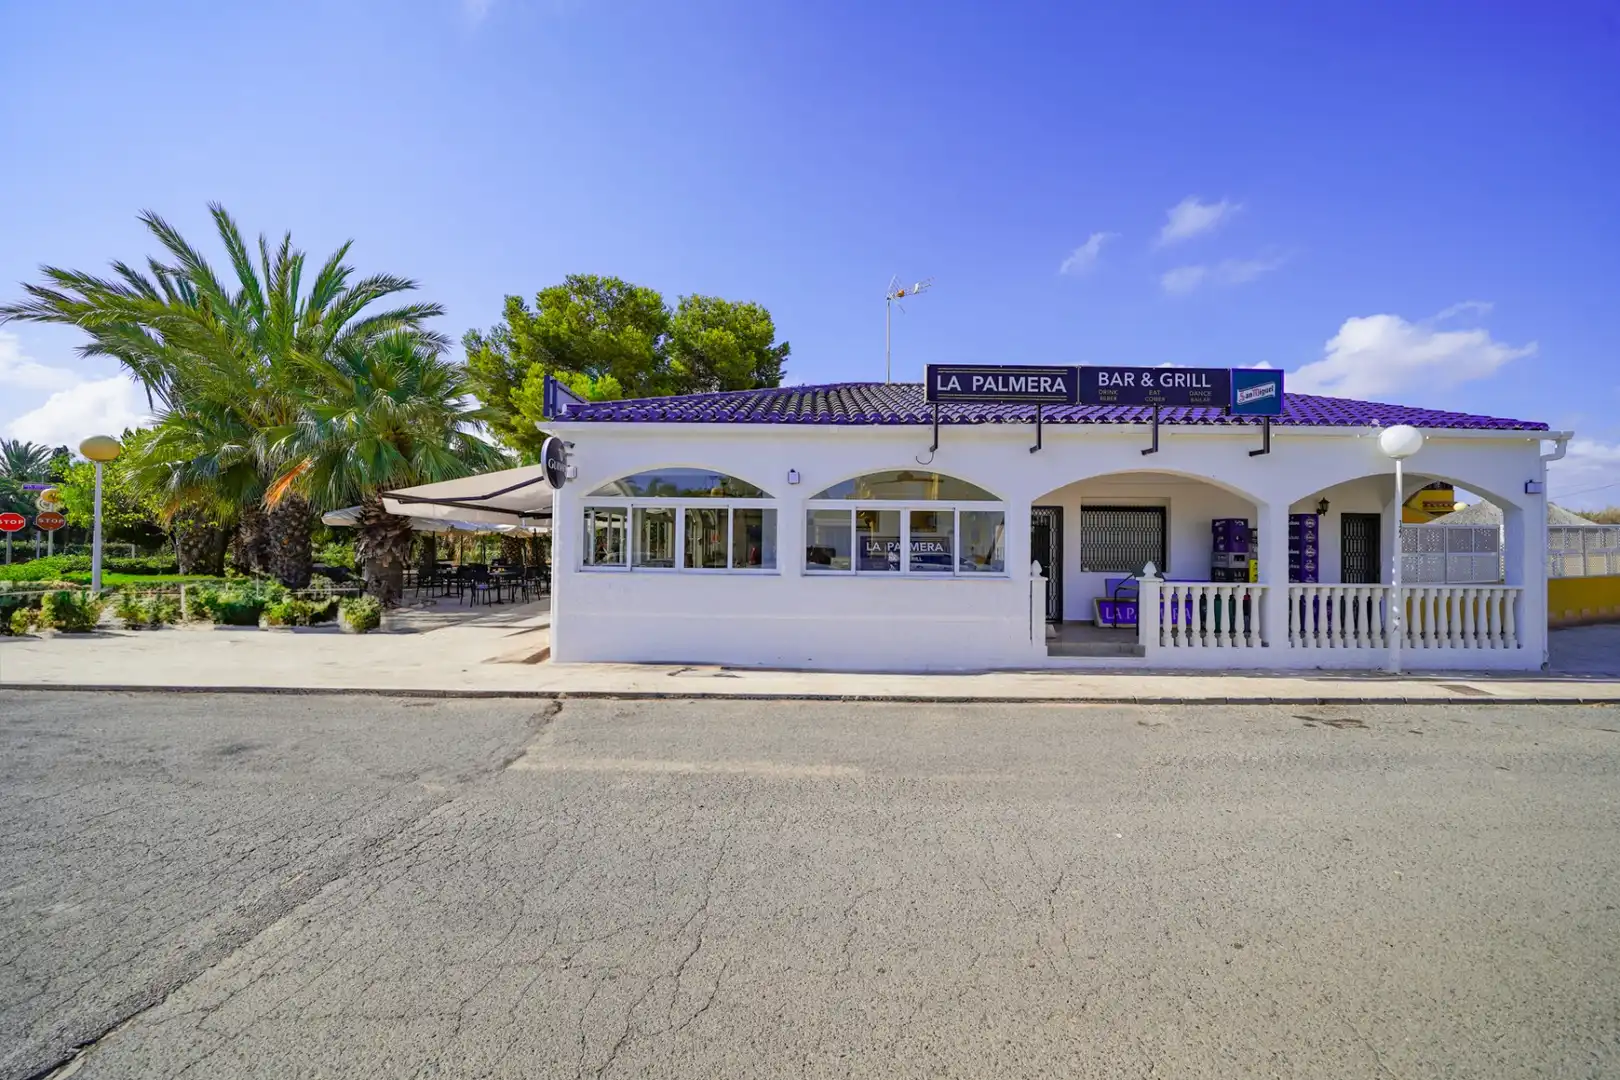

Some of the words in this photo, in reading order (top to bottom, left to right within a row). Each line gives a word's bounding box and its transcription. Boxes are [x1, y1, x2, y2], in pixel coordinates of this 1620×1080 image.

[937, 375, 962, 391] LA
[972, 376, 1067, 393] PALMERA
[1098, 371, 1135, 387] BAR
[1140, 372, 1155, 387] &
[1159, 373, 1212, 388] GRILL
[866, 542, 881, 551] LA
[887, 542, 944, 552] PAMERA
